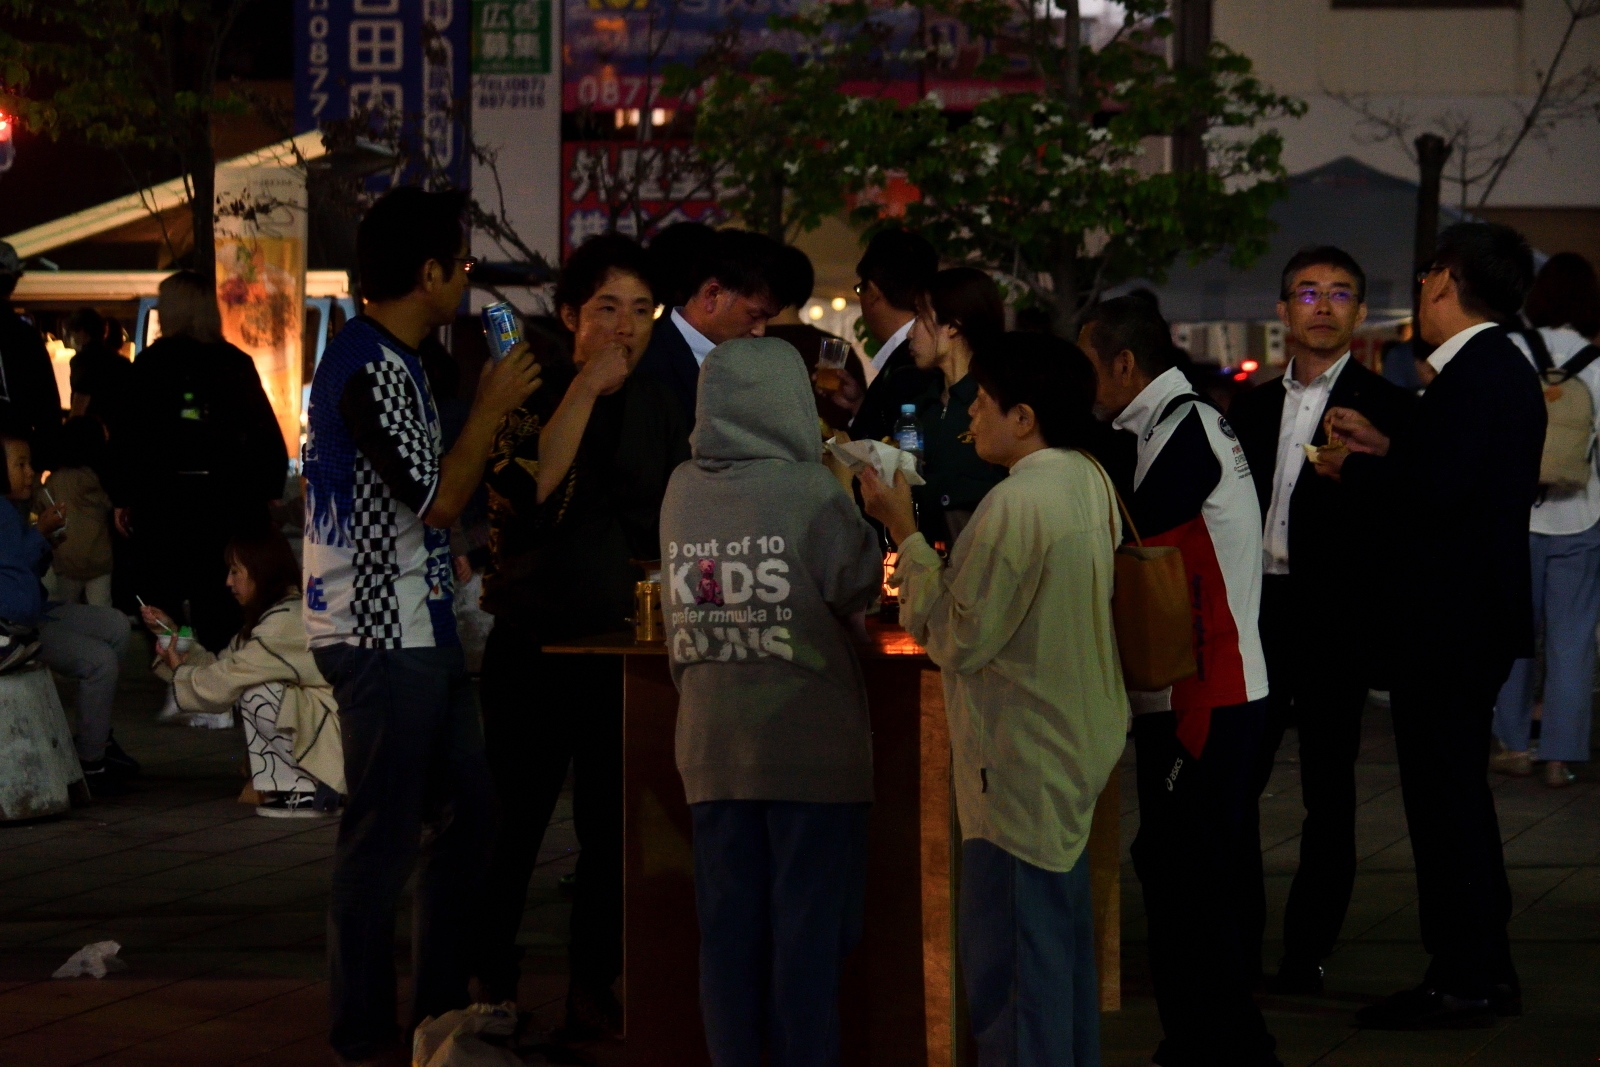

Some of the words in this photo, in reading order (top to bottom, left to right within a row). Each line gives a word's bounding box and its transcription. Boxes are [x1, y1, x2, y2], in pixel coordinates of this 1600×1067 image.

[481, 2, 541, 28] 広告
[481, 31, 541, 59] 募集
[669, 541, 679, 559] 9
[682, 539, 720, 557] out
[726, 536, 750, 556] of
[757, 535, 785, 555] 10
[775, 605, 793, 621] to
